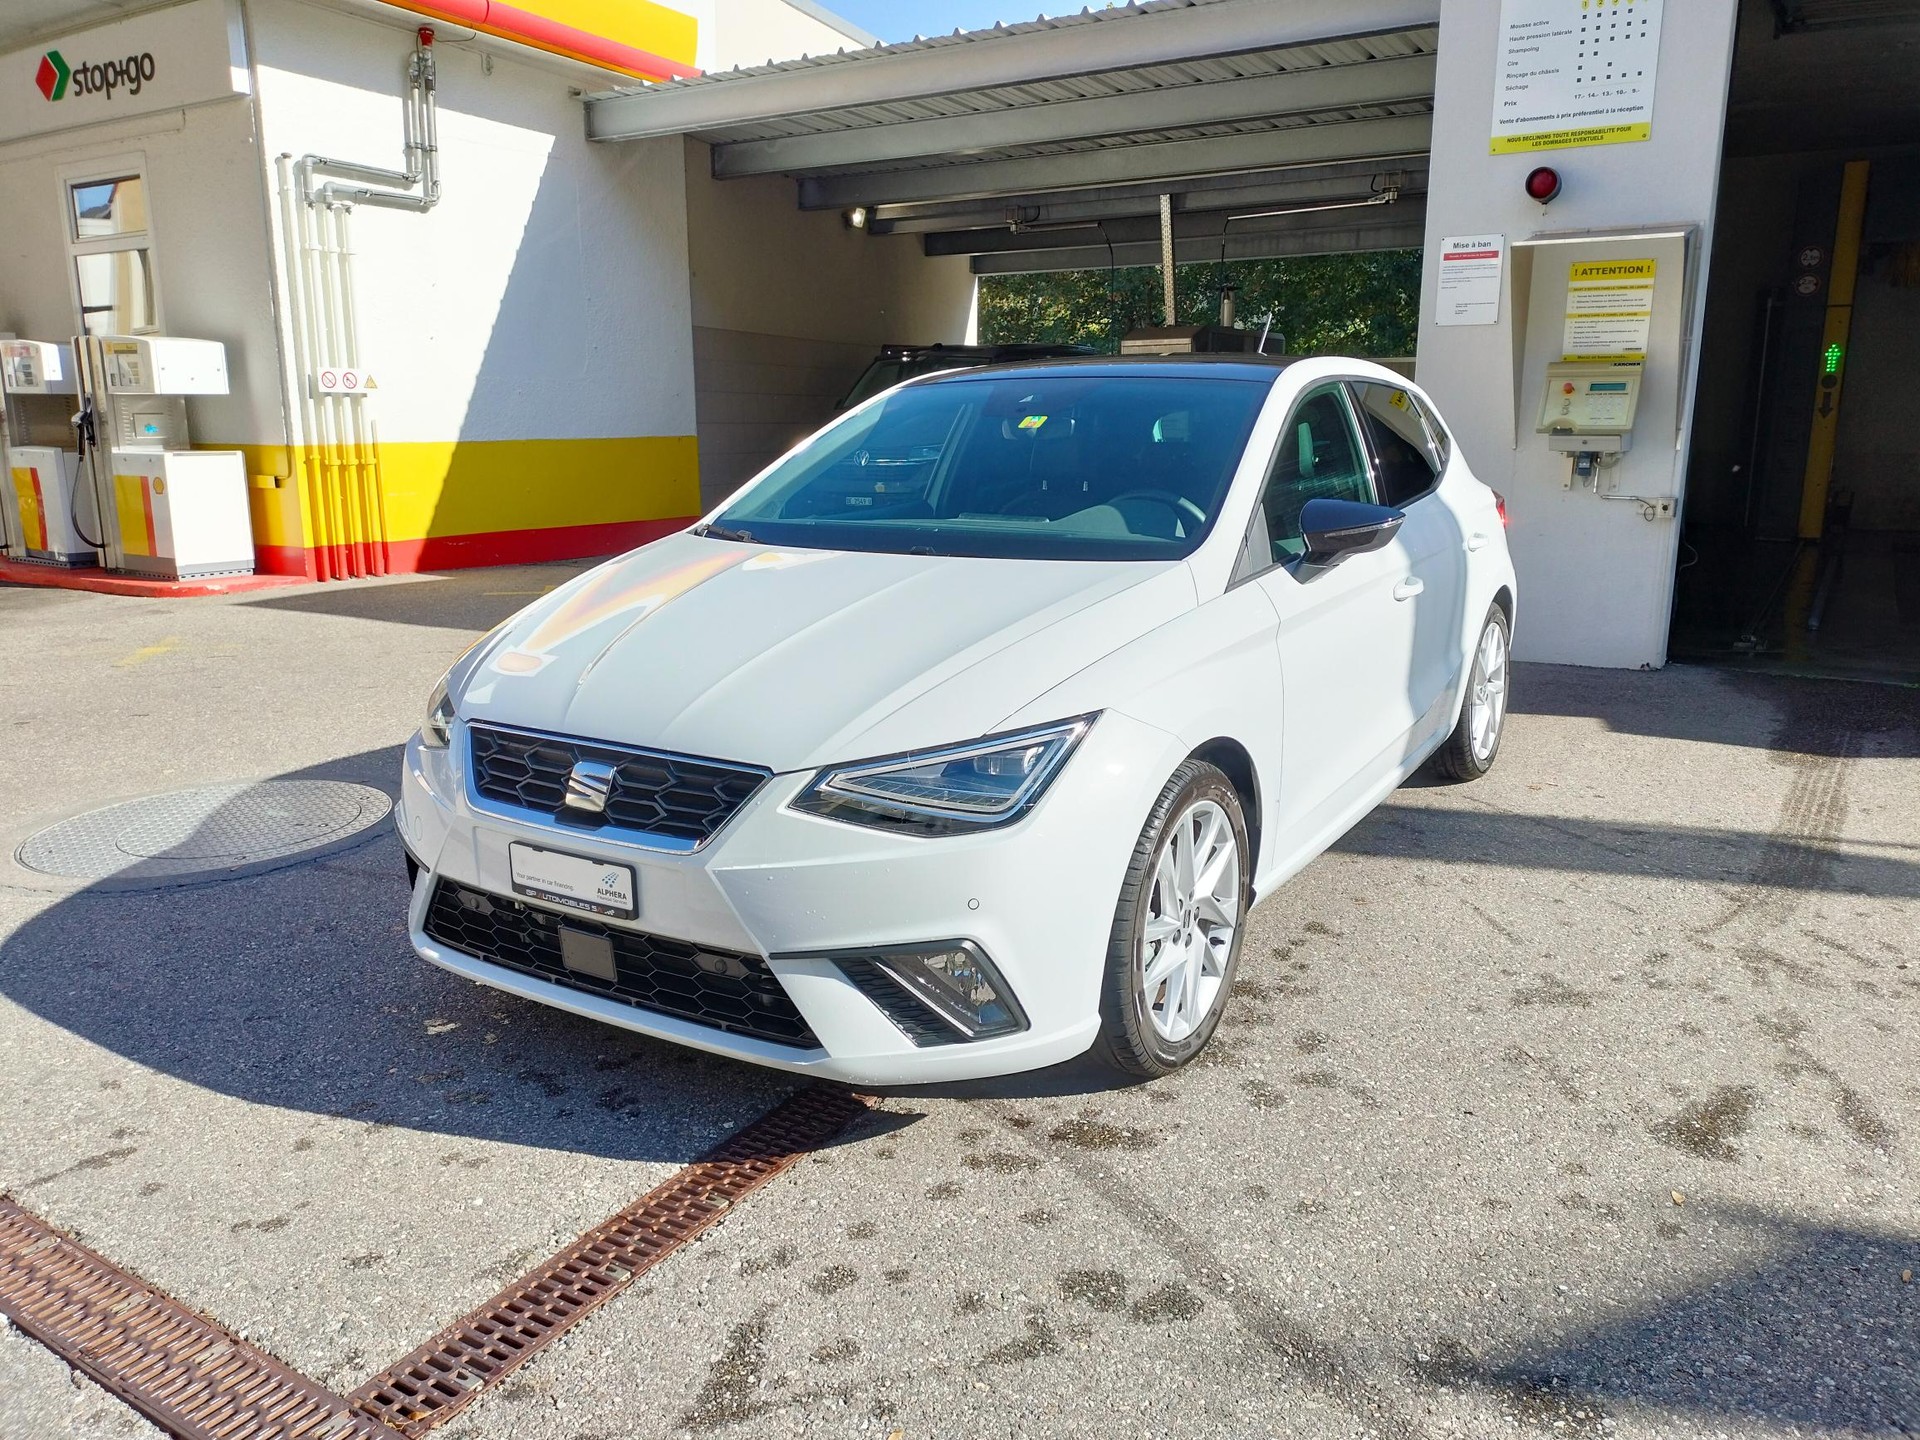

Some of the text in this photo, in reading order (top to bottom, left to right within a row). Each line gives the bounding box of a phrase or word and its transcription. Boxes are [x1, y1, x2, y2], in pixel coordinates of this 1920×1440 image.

[1508, 46, 1539, 54] Shampoing
[72, 52, 155, 100] stop+go
[1515, 114, 1555, 123] d'abonnements
[1571, 128, 1615, 136] RESPONSABILITE
[1581, 266, 1644, 276] ATTENTION
[597, 887, 627, 900] ALPHERA
[537, 891, 590, 910] AUTOMOBILES
